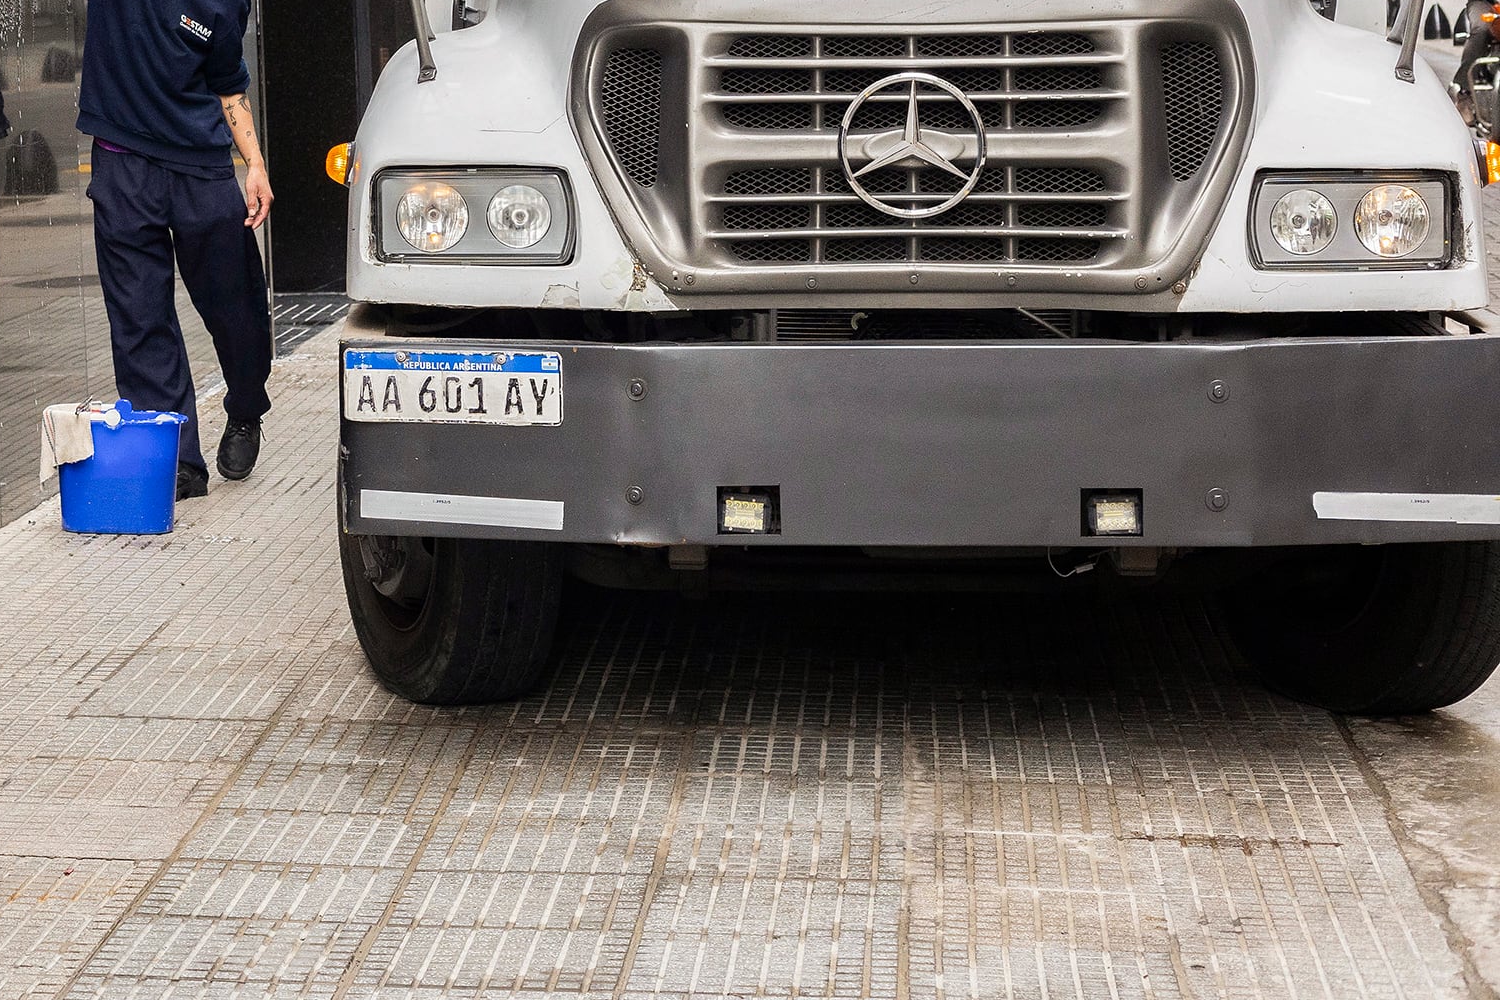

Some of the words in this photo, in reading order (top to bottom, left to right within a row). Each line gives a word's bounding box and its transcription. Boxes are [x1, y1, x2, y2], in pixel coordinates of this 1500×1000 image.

[403, 361, 450, 370] REPUBLICA
[453, 361, 503, 371] ARGENTINA
[356, 375, 402, 413] AA
[418, 376, 488, 414] 601
[504, 377, 549, 416] AY
